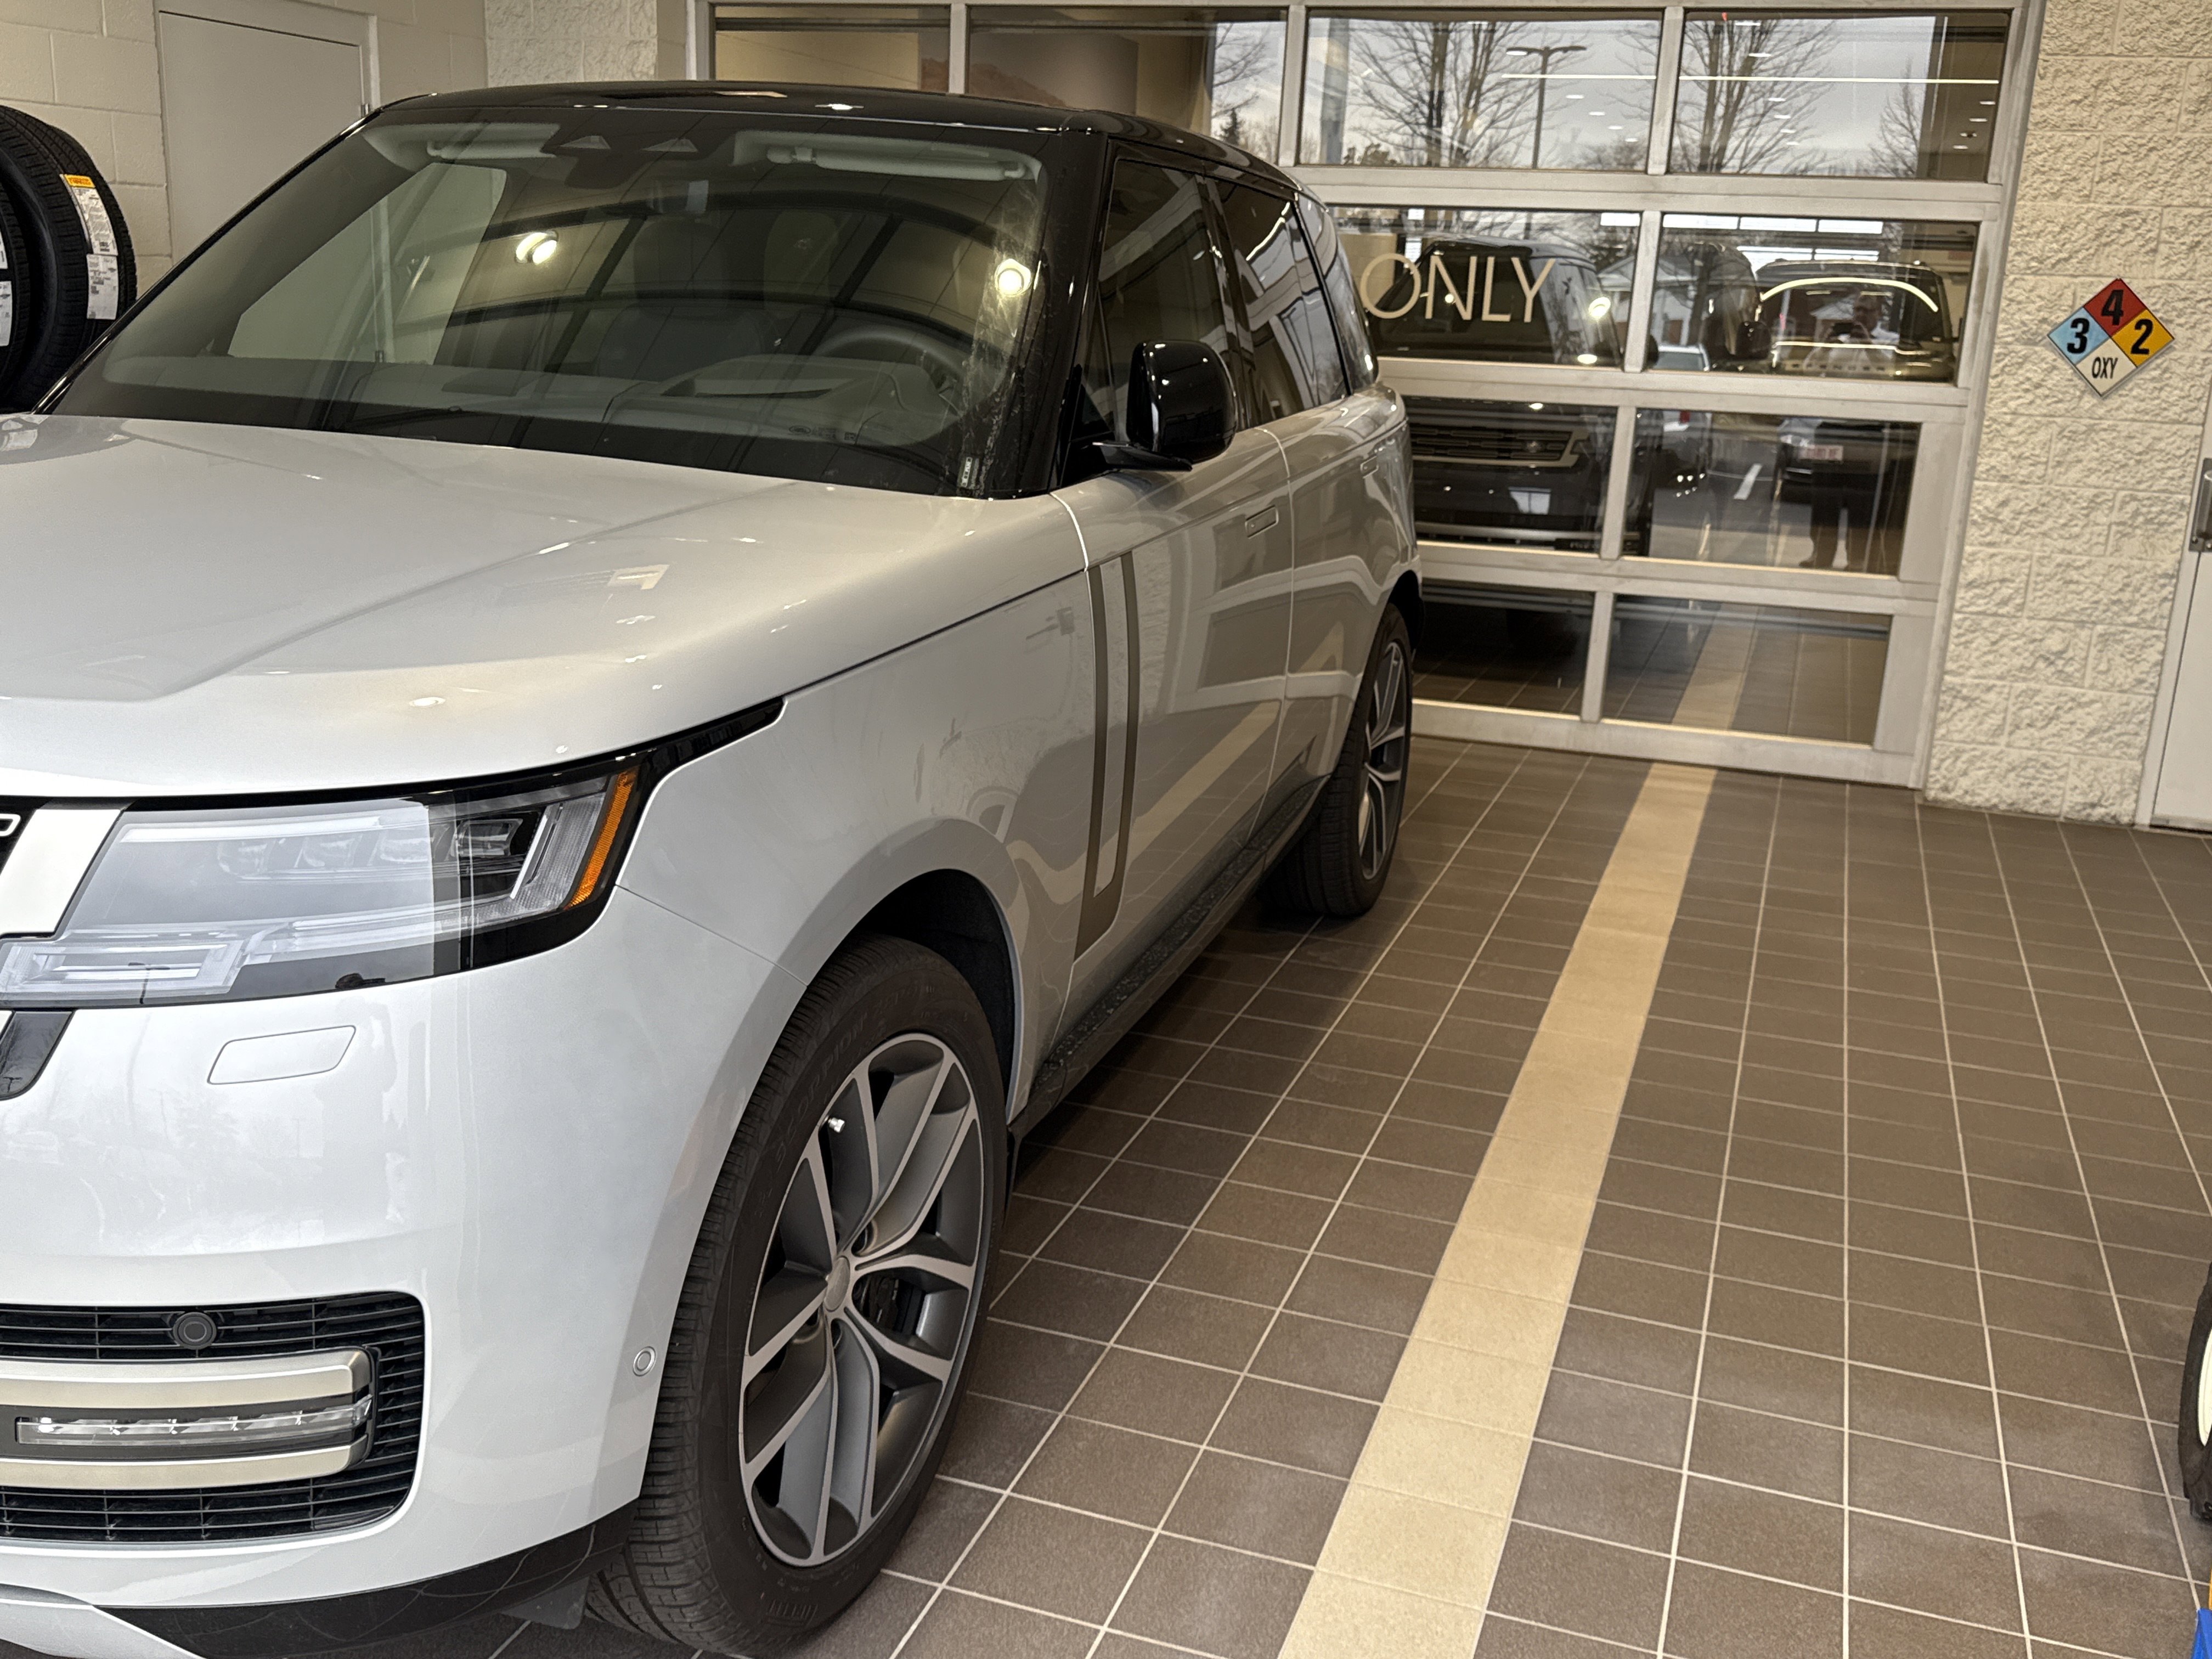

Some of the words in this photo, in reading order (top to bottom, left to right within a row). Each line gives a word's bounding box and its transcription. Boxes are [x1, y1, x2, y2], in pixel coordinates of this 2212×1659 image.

[1360, 253, 1556, 323] ONLY
[2101, 290, 2124, 325] 4
[2067, 318, 2090, 354] 3
[2130, 319, 2153, 354] 2
[2091, 357, 2118, 379] OXY
